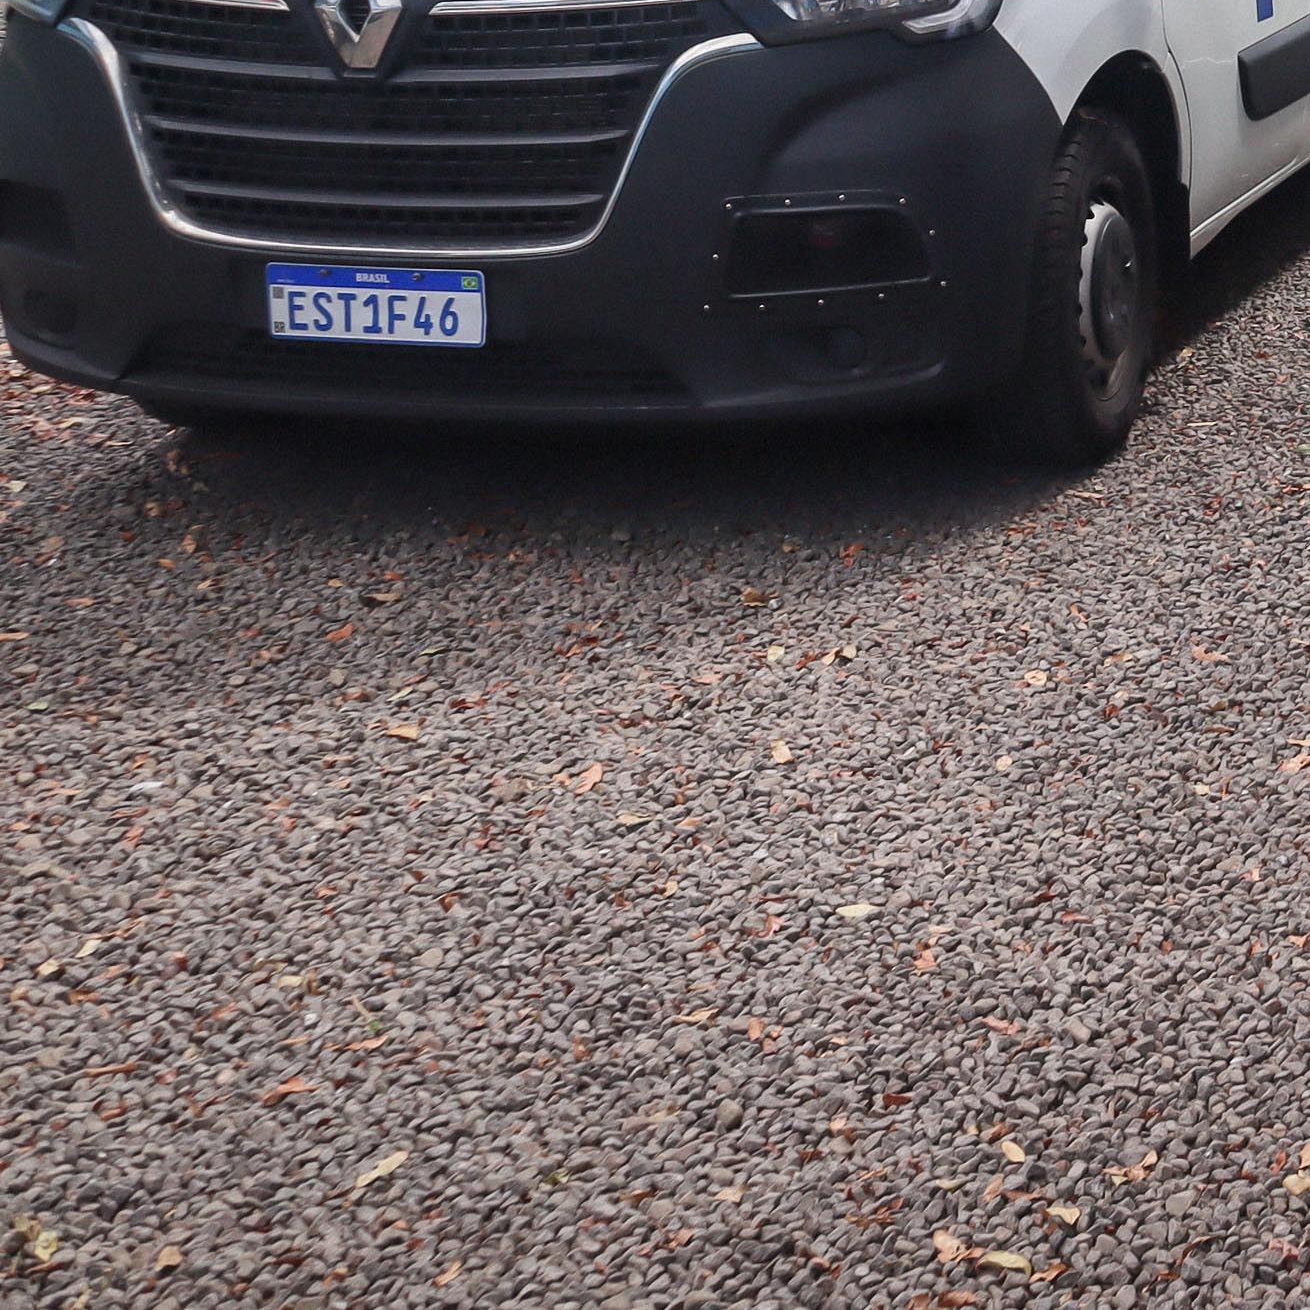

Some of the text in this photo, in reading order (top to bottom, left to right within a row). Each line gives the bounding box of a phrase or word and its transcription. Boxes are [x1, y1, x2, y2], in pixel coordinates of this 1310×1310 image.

[355, 272, 391, 284] BRASIL
[287, 291, 460, 337] EST1F46
[273, 321, 285, 333] BR
